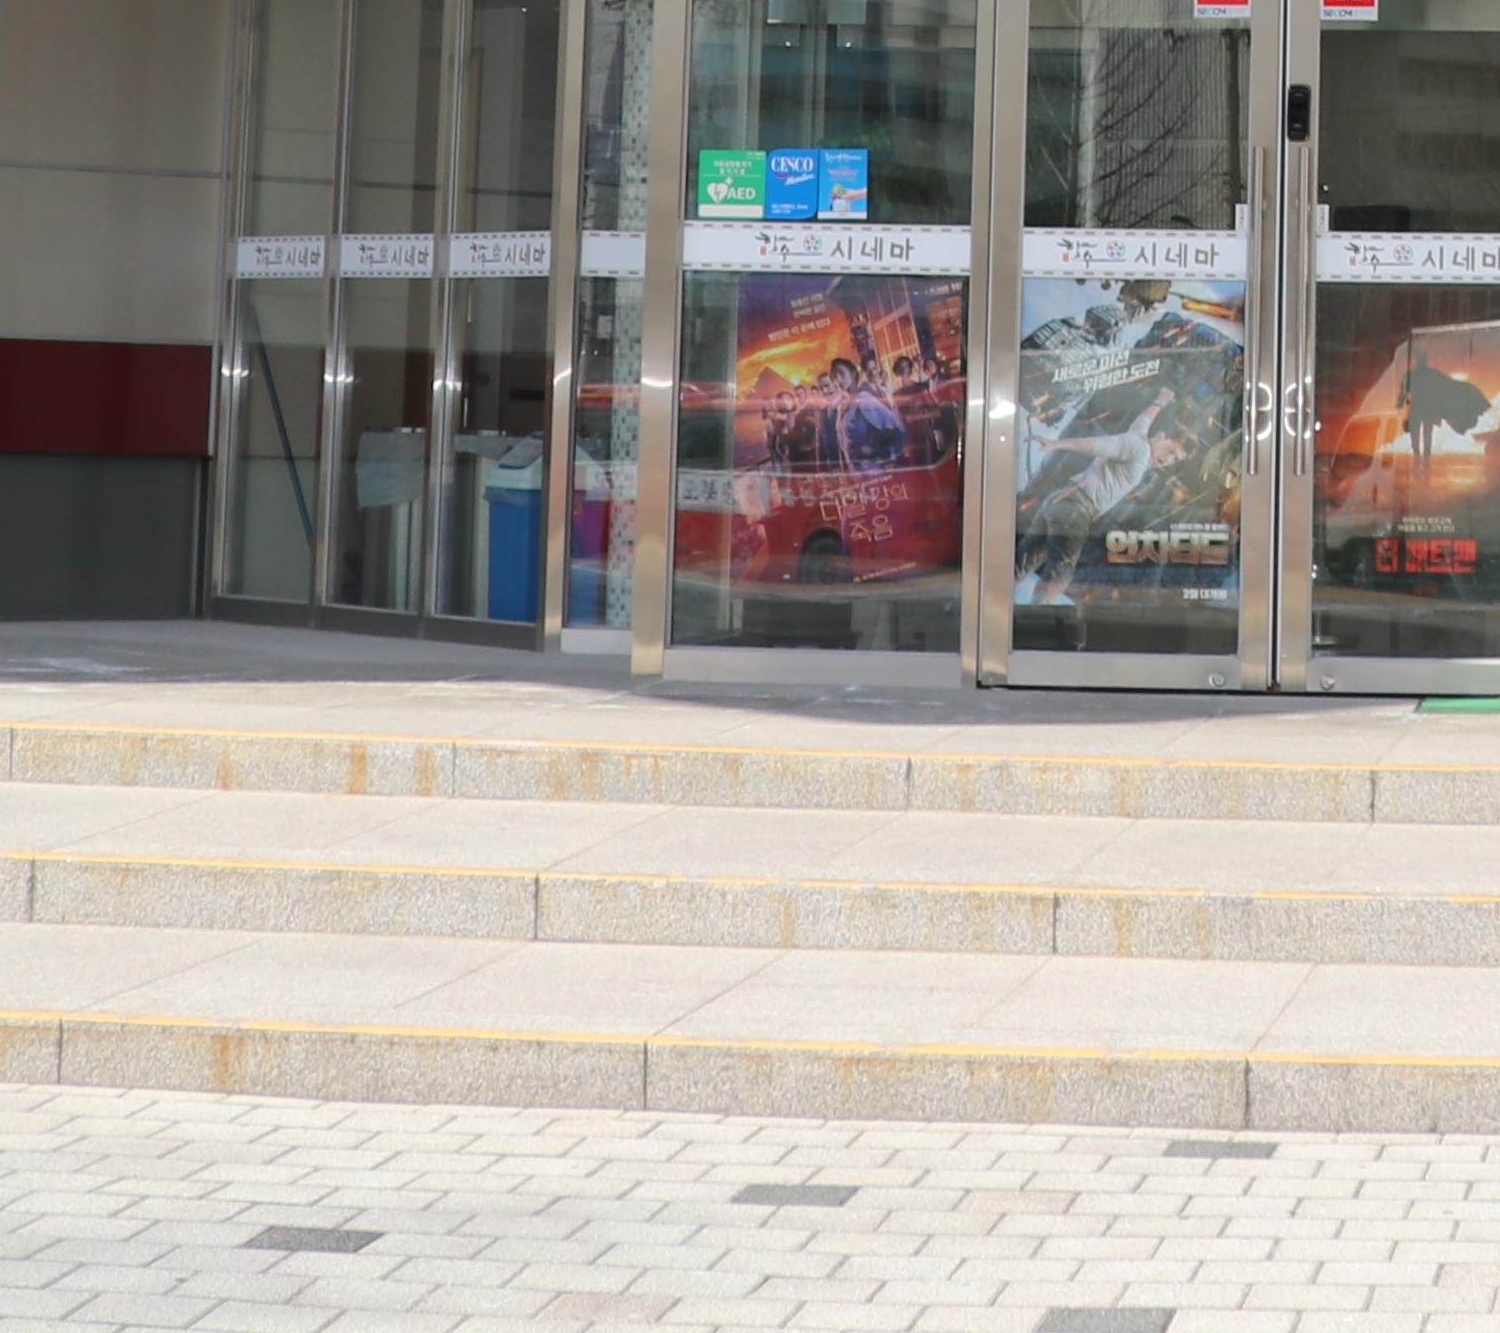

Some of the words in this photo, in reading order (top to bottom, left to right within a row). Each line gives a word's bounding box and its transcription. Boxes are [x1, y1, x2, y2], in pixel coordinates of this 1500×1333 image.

[771, 157, 814, 172] CESCO
[726, 187, 757, 200] AED
[286, 245, 322, 267] 시네마
[390, 245, 431, 267] 시네마
[505, 242, 546, 265] 시네마
[830, 237, 915, 261] 시네마
[1133, 243, 1220, 267] 시네마
[1051, 358, 1098, 383] 새로운
[1082, 368, 1129, 393] 위험한
[1130, 358, 1161, 378] 도전
[850, 515, 894, 542] 죽음
[1106, 530, 1230, 564] 언차티드
[1375, 538, 1399, 572] 더
